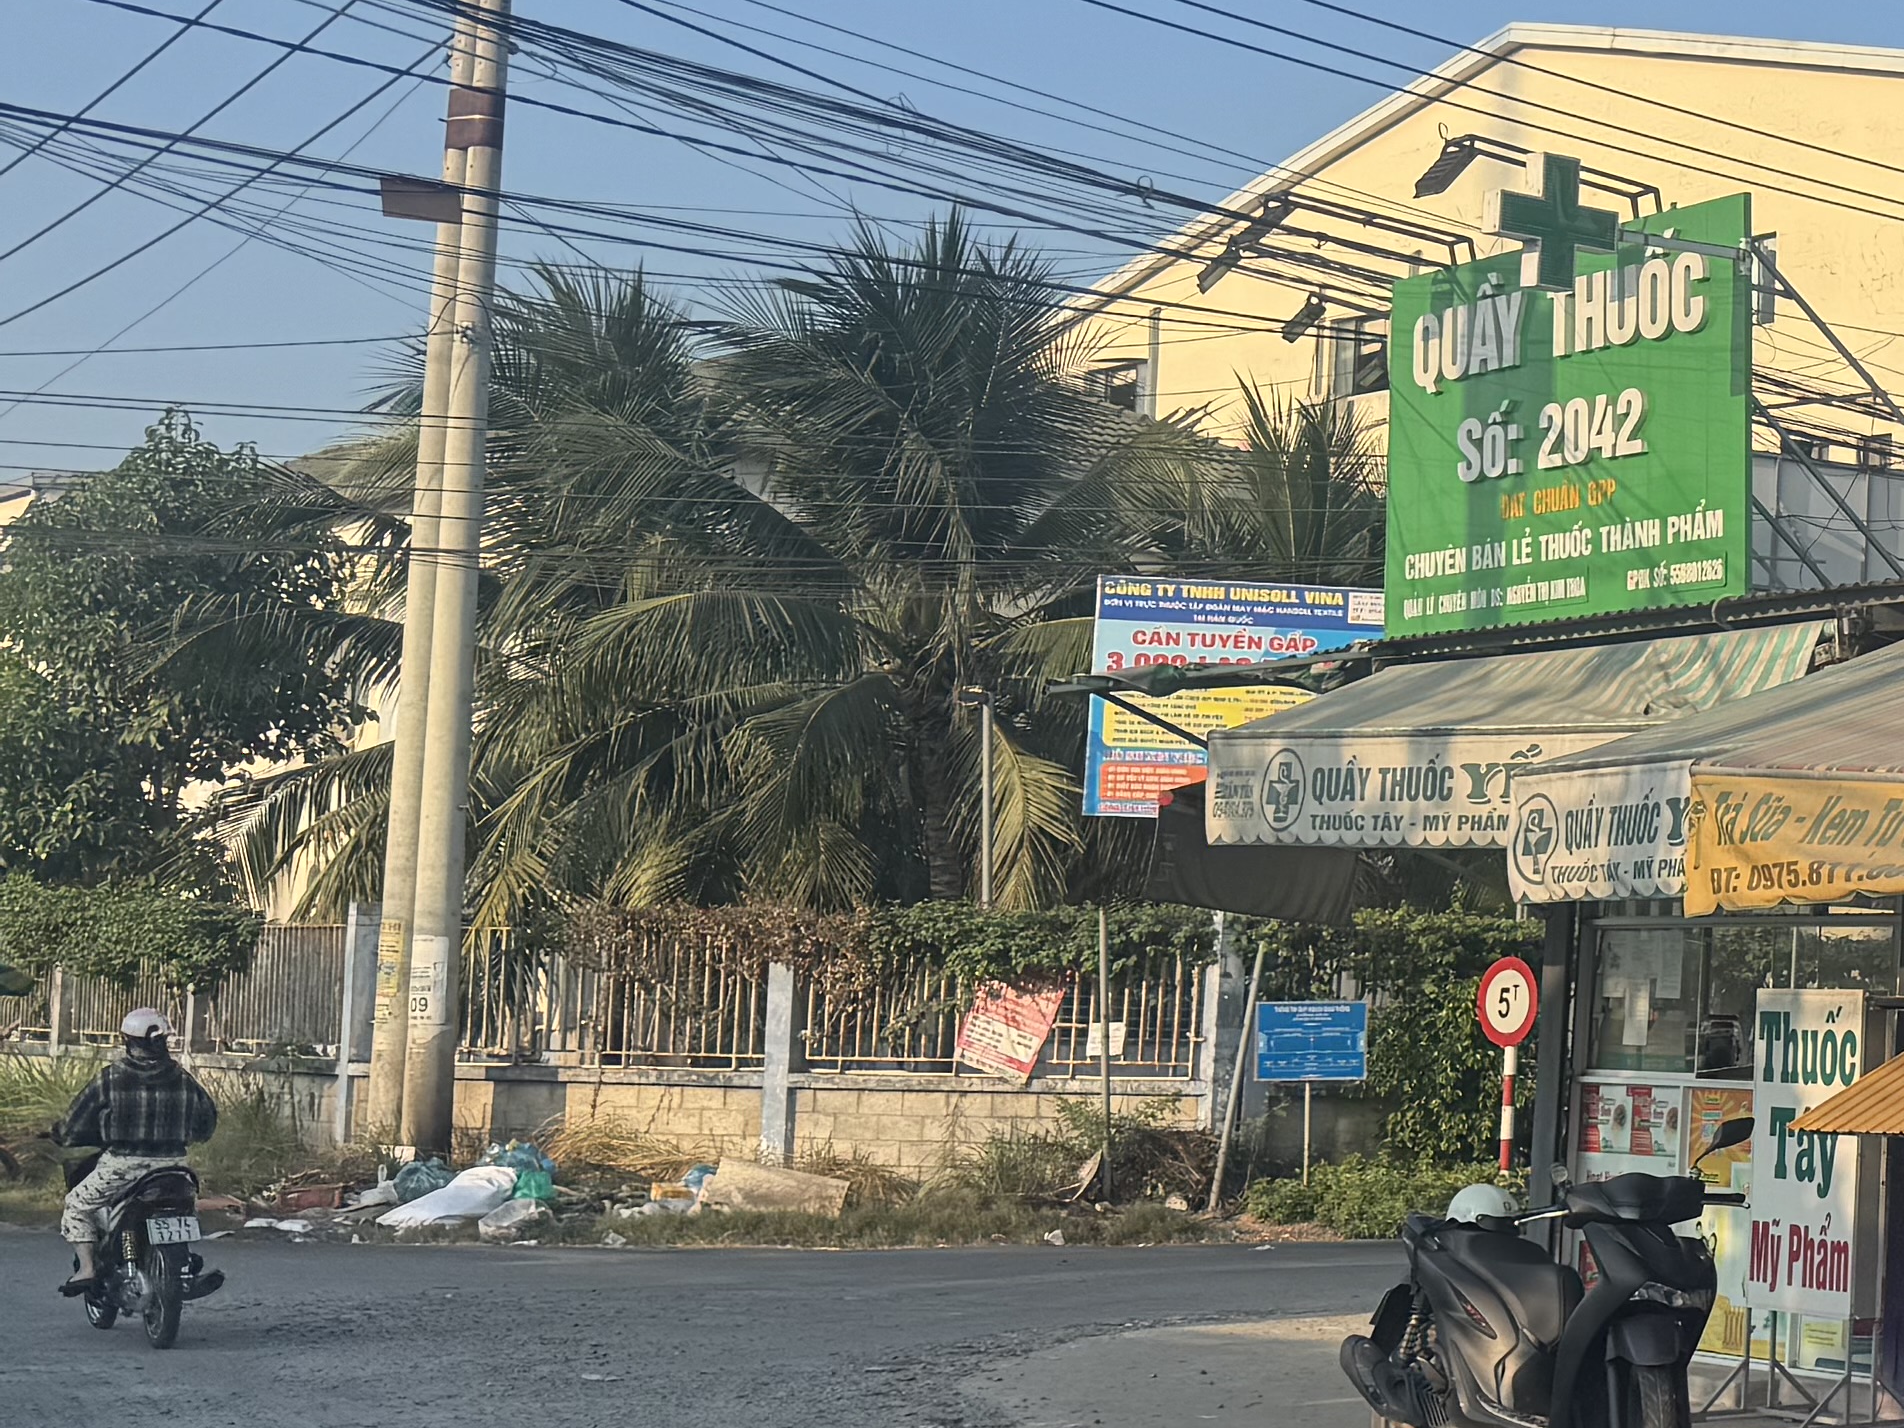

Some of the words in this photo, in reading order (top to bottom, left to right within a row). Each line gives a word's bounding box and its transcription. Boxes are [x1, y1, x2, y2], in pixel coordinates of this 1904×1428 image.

[1412, 272, 1527, 395] QUẦY
[1547, 227, 1708, 358] THUỐC
[1537, 387, 1648, 471] 2042
[1588, 478, 1617, 508] GPP
[1404, 543, 1467, 581] CHUYÊN
[1471, 538, 1506, 571] BÁN
[1511, 527, 1533, 565] LẺ
[1538, 521, 1593, 562] THUỐC
[1599, 517, 1661, 554] THÀNH
[1666, 499, 1725, 545] PHẨM
[1157, 583, 1177, 598] TY
[1181, 584, 1227, 600] TNHH
[1231, 586, 1302, 604] UNISOLL
[1305, 589, 1345, 606] VINA
[1268, 629, 1317, 654] GẤP
[1311, 754, 1372, 805] QUẦY
[1378, 753, 1455, 802] THUỐC
[1310, 808, 1365, 832] THUỐC
[1371, 811, 1403, 832] TÂY
[1422, 809, 1451, 832] MỸ
[1607, 787, 1662, 847] THUỐC
[1797, 795, 1871, 846] Kem
[1550, 858, 1599, 885] THUỐC
[1633, 854, 1654, 881] MỸ
[1758, 1005, 1858, 1087] Thuốc
[1748, 1218, 1782, 1293] Mỹ
[1787, 1212, 1849, 1293] Phẩm
